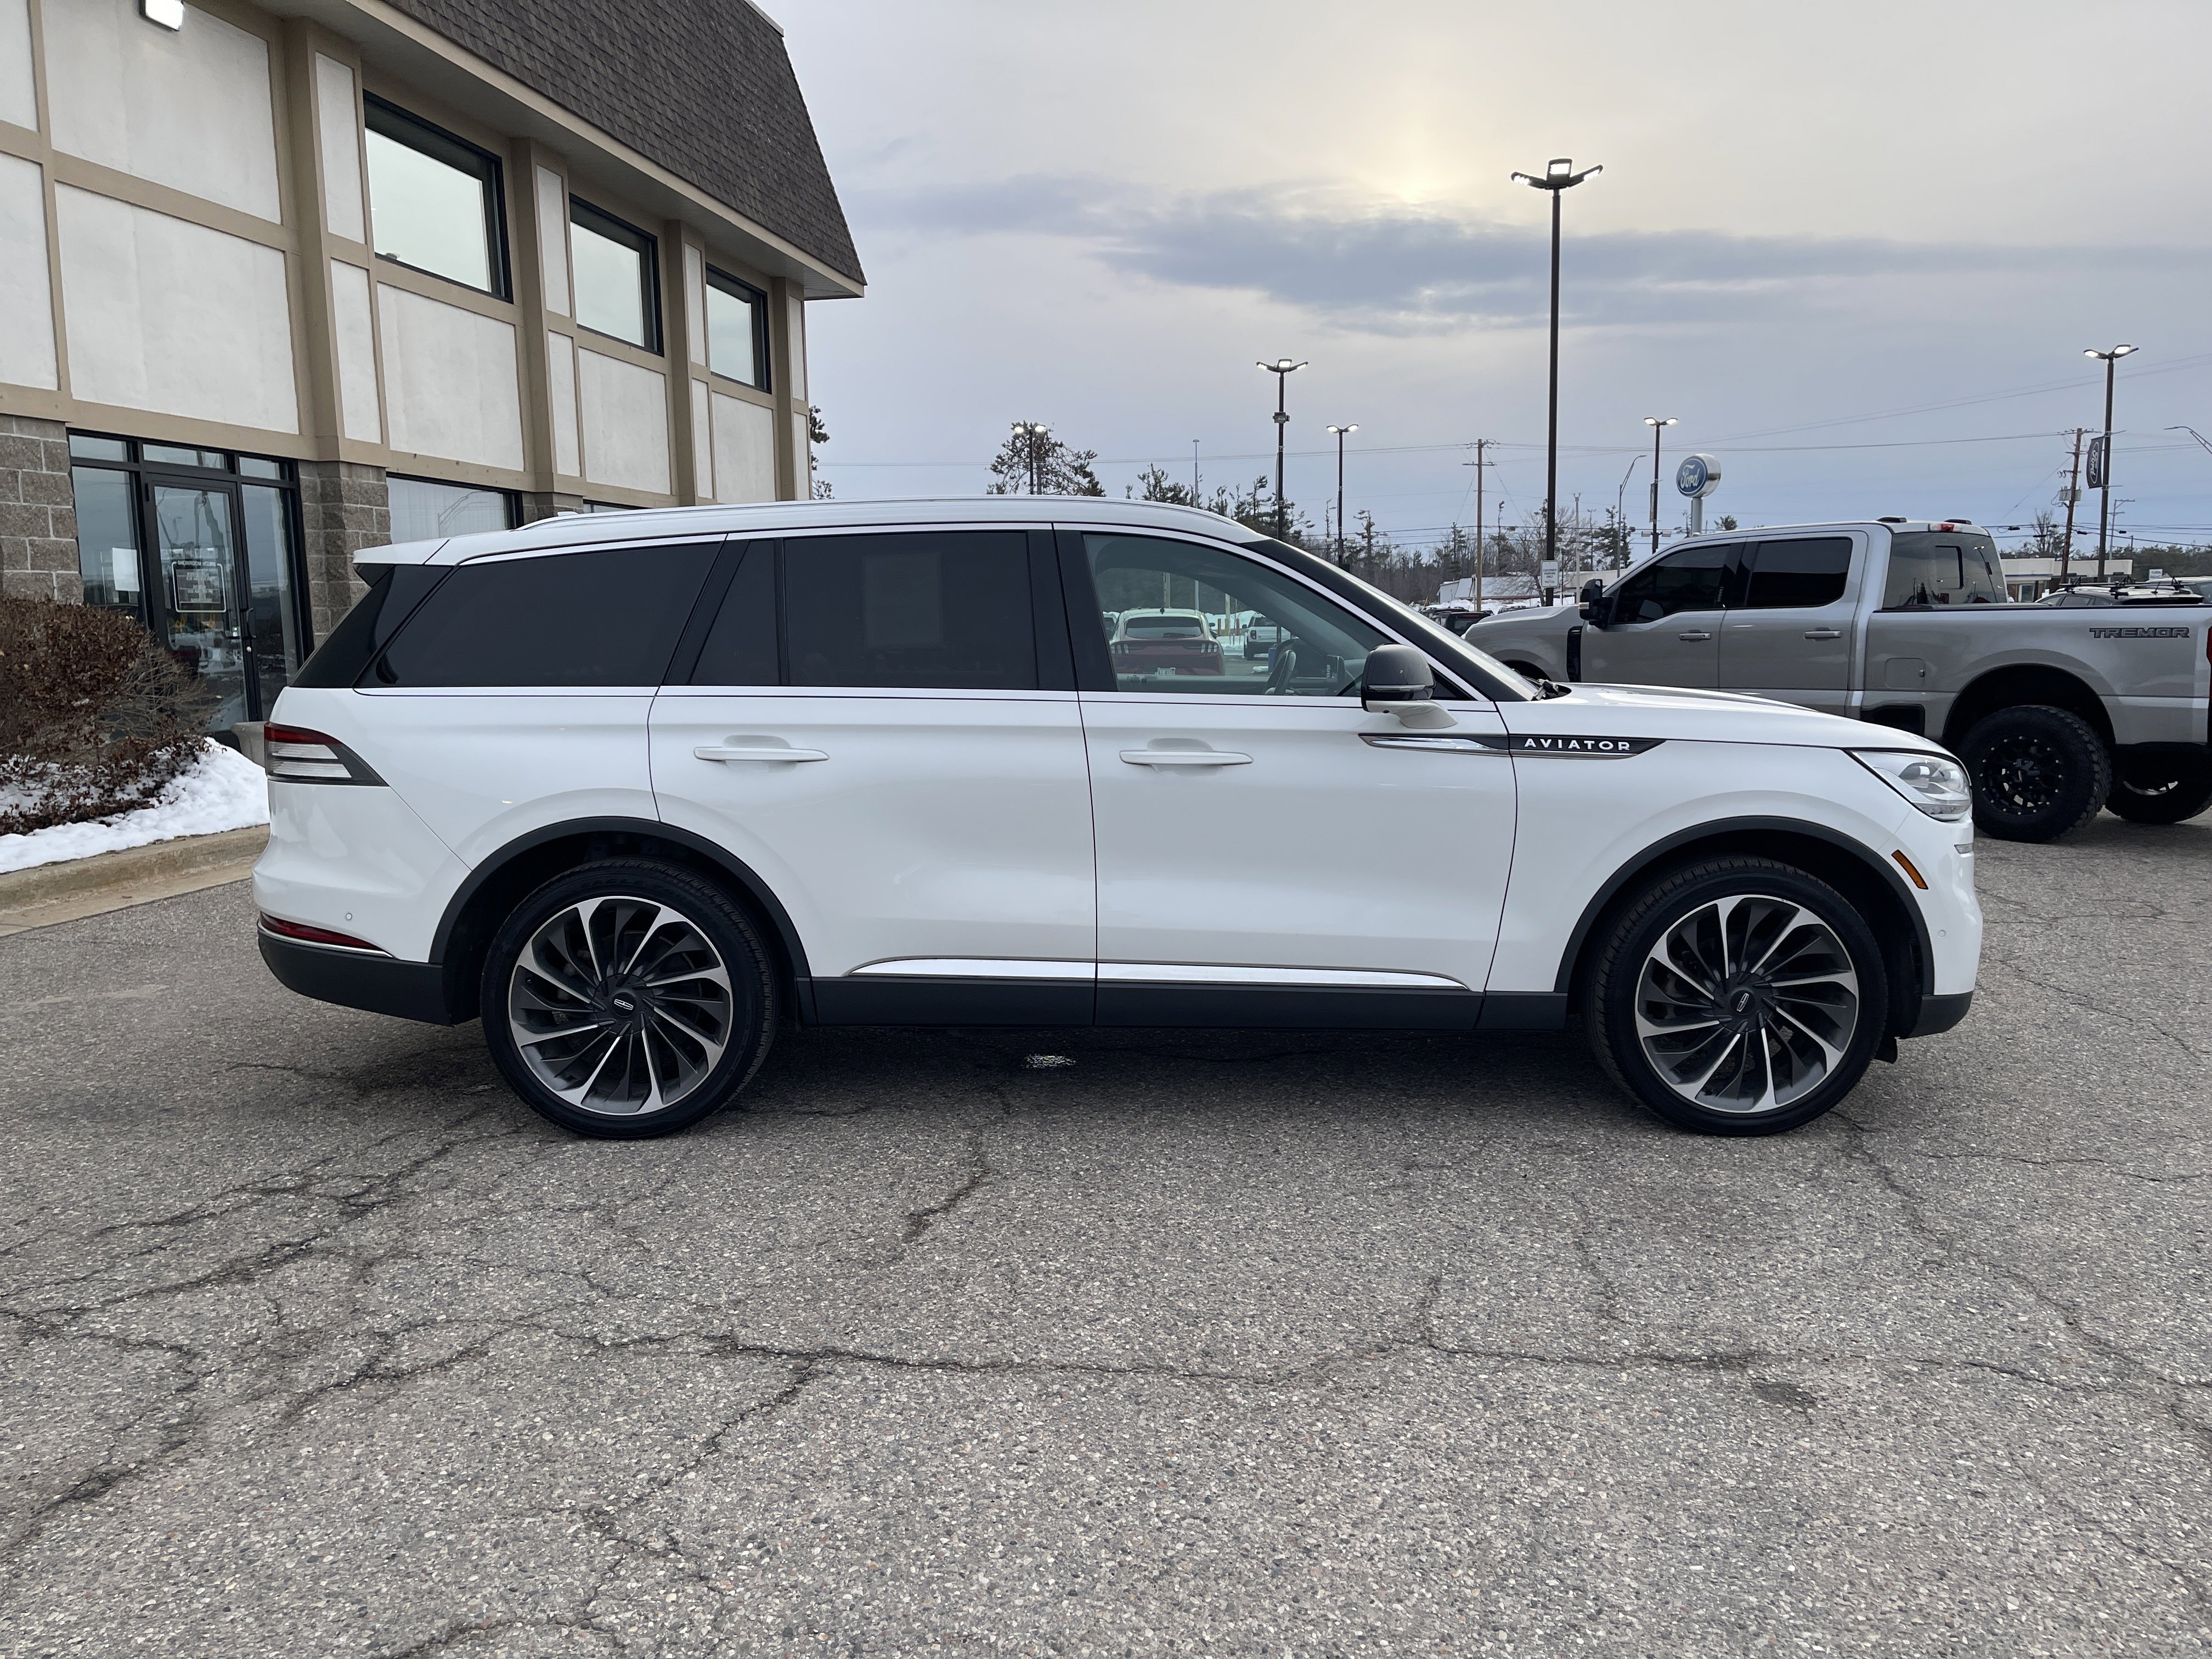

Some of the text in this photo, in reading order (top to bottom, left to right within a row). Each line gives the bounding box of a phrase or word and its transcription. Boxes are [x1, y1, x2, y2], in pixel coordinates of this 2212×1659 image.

[2090, 450, 2098, 476] Ford
[1680, 464, 1700, 489] Ford
[2089, 628, 2190, 639] TREMOR
[1524, 738, 1630, 751] AVIATOR
